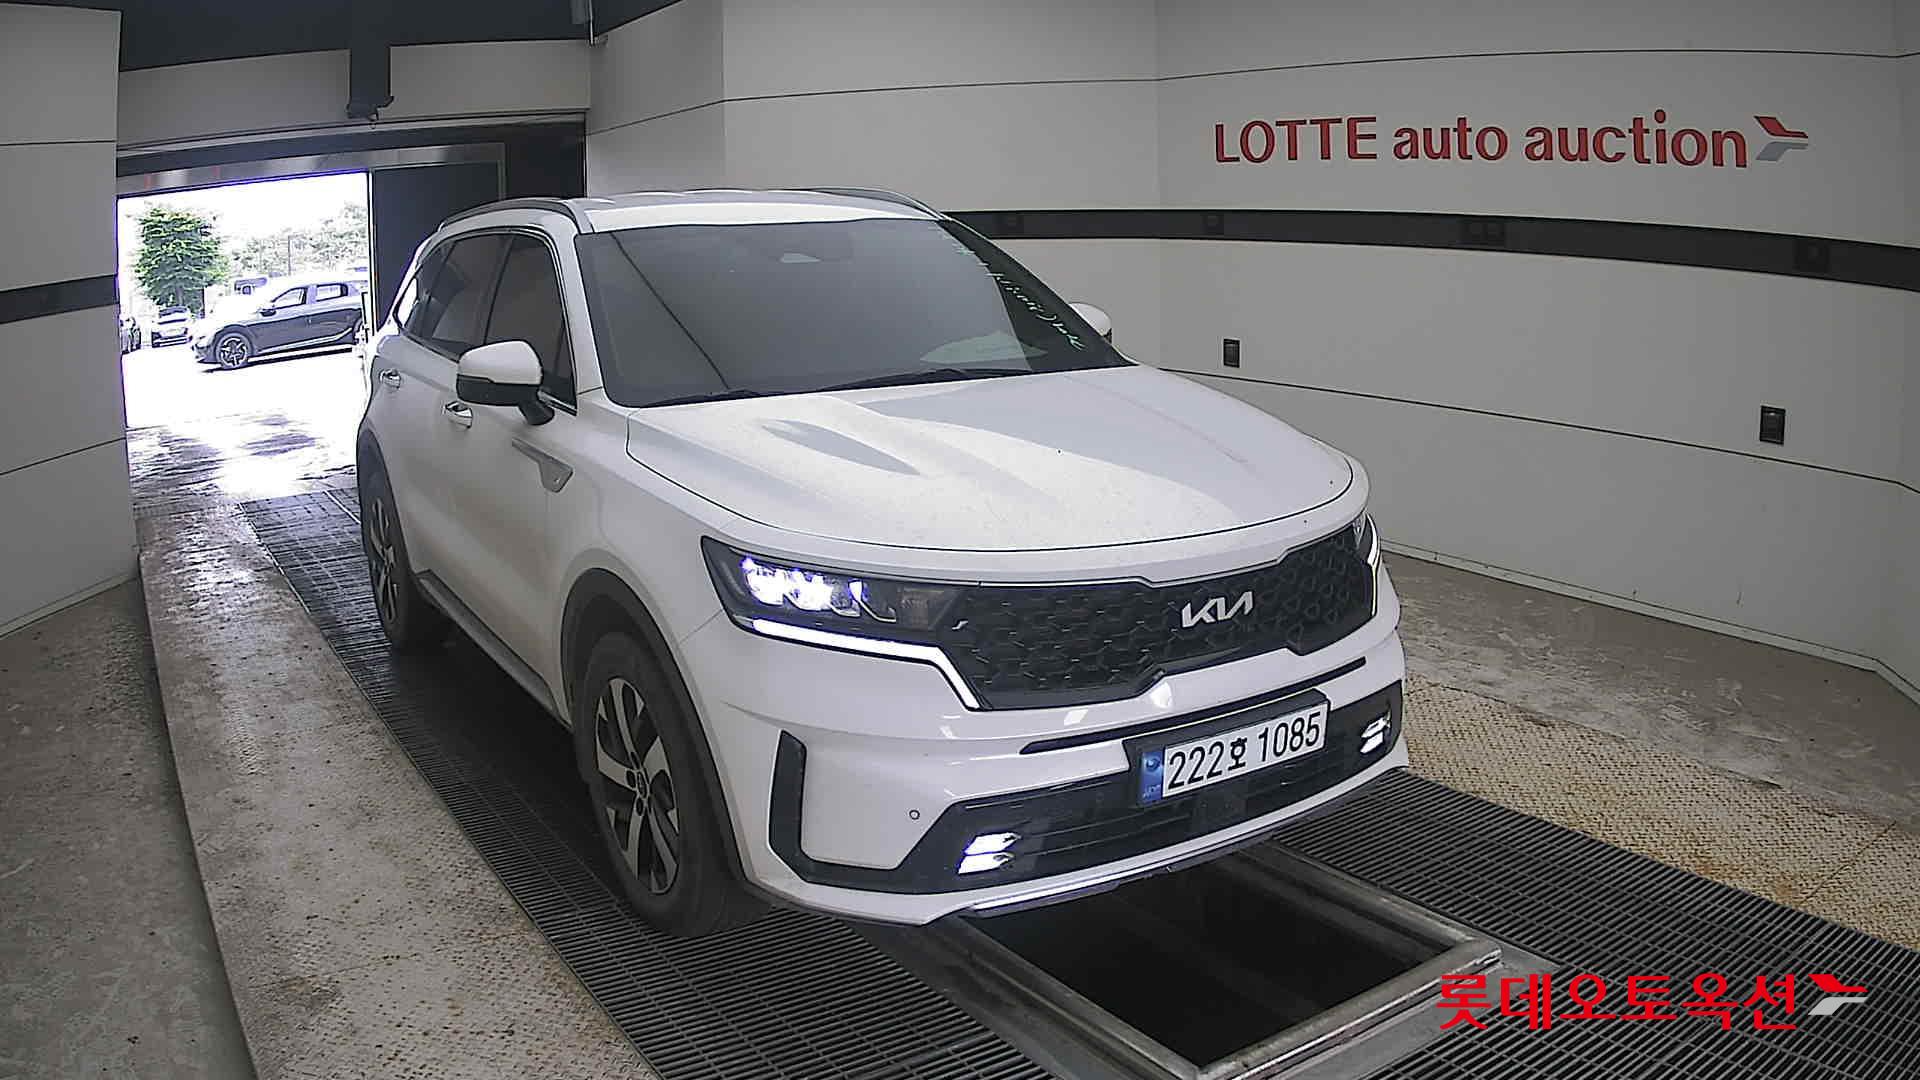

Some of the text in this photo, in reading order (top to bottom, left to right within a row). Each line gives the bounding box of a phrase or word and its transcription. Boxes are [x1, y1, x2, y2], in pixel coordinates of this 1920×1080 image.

[1214, 108, 1749, 169] LOTTE auto auction
[1167, 711, 1321, 790] 222호 1085
